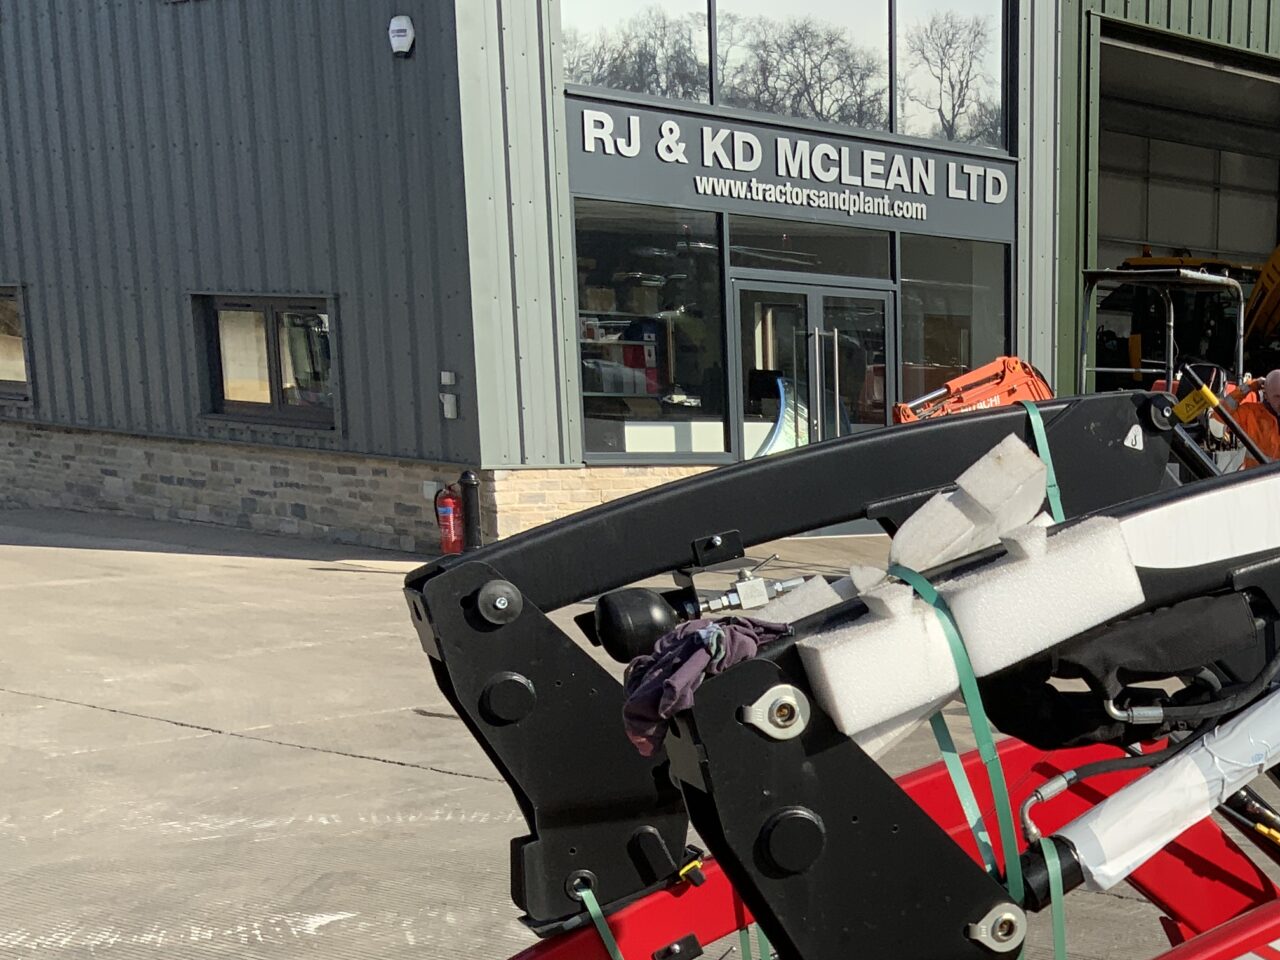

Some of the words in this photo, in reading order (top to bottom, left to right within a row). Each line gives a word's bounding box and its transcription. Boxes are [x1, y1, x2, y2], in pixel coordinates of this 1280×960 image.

[583, 109, 641, 158] RJ
[657, 120, 689, 164] &
[702, 126, 763, 172] KD
[777, 137, 936, 196] MCLEAN
[948, 161, 1008, 204] LTD
[695, 175, 927, 220] www.tractorsandplant.com
